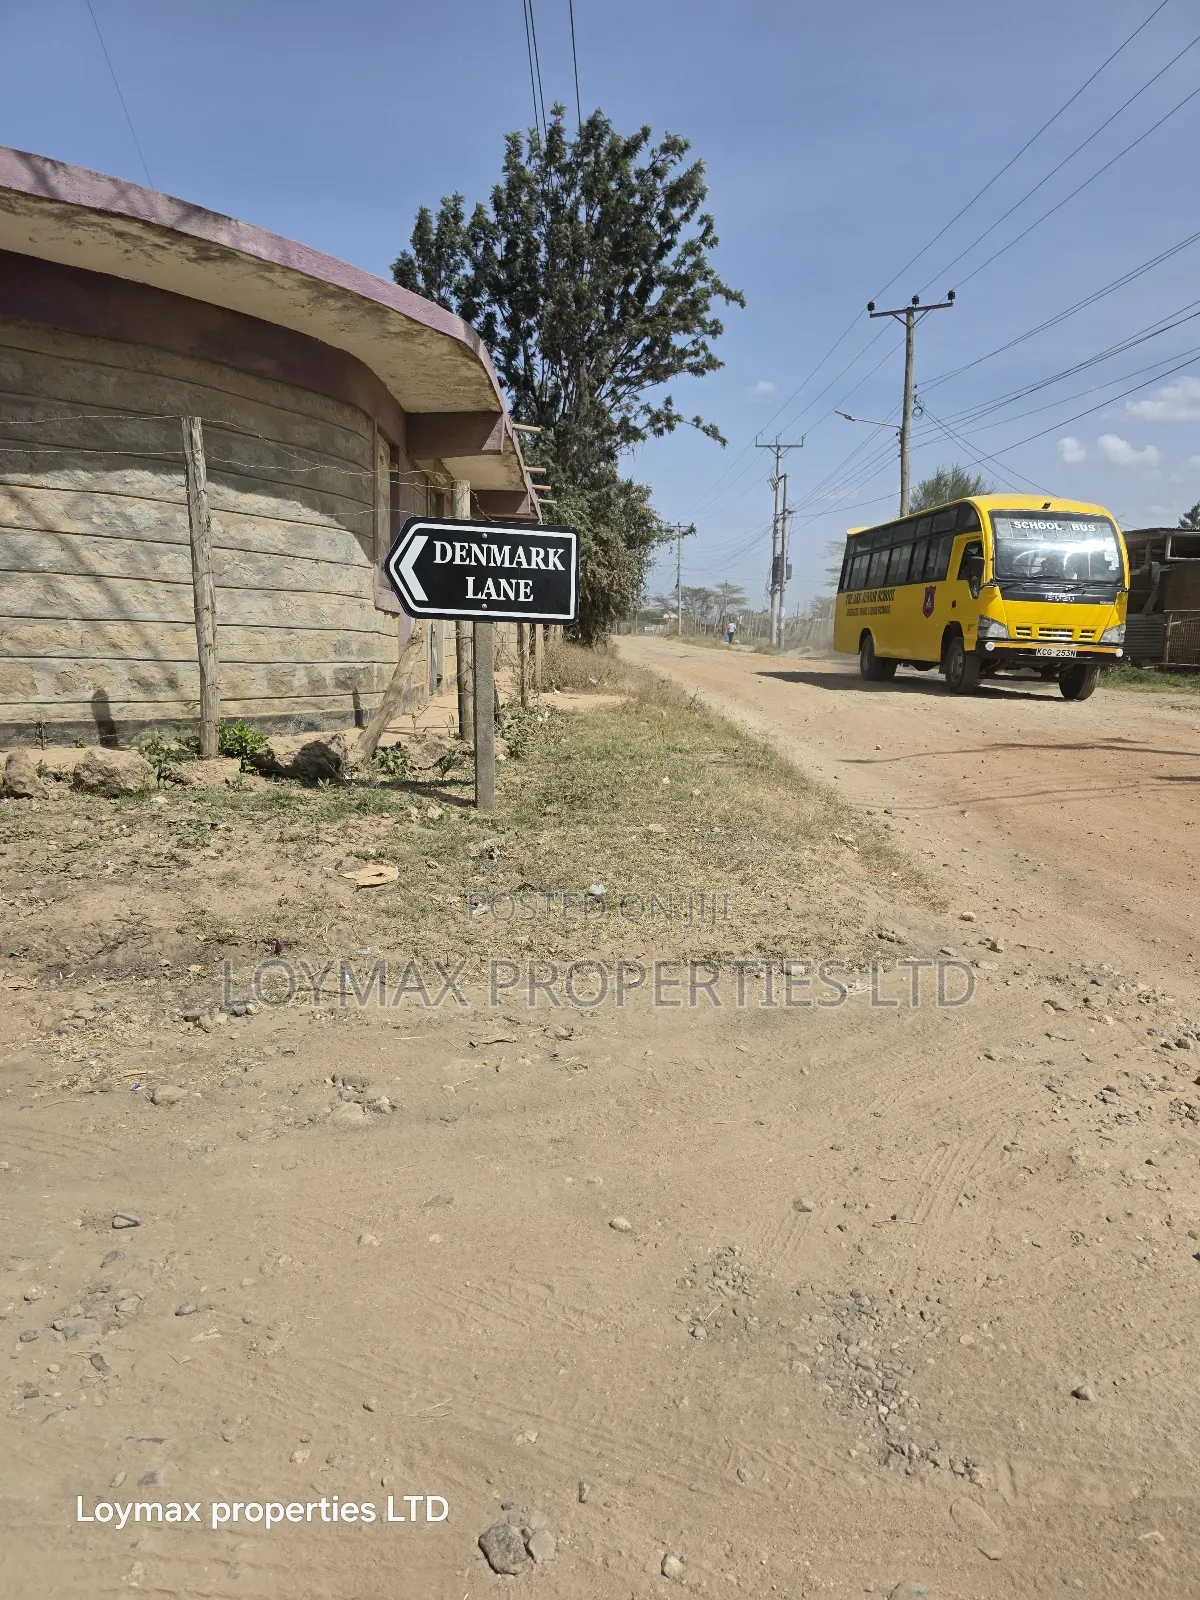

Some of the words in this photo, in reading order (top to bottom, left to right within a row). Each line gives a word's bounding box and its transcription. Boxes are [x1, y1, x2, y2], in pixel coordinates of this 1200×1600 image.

[1013, 521, 1062, 531] SCHOOL
[1071, 523, 1096, 532] BUS
[433, 540, 566, 571] DENMARK
[465, 576, 534, 602] LANE
[876, 589, 895, 603] SCHOOL
[1036, 648, 1053, 656] KCG
[1056, 649, 1076, 657] 253N
